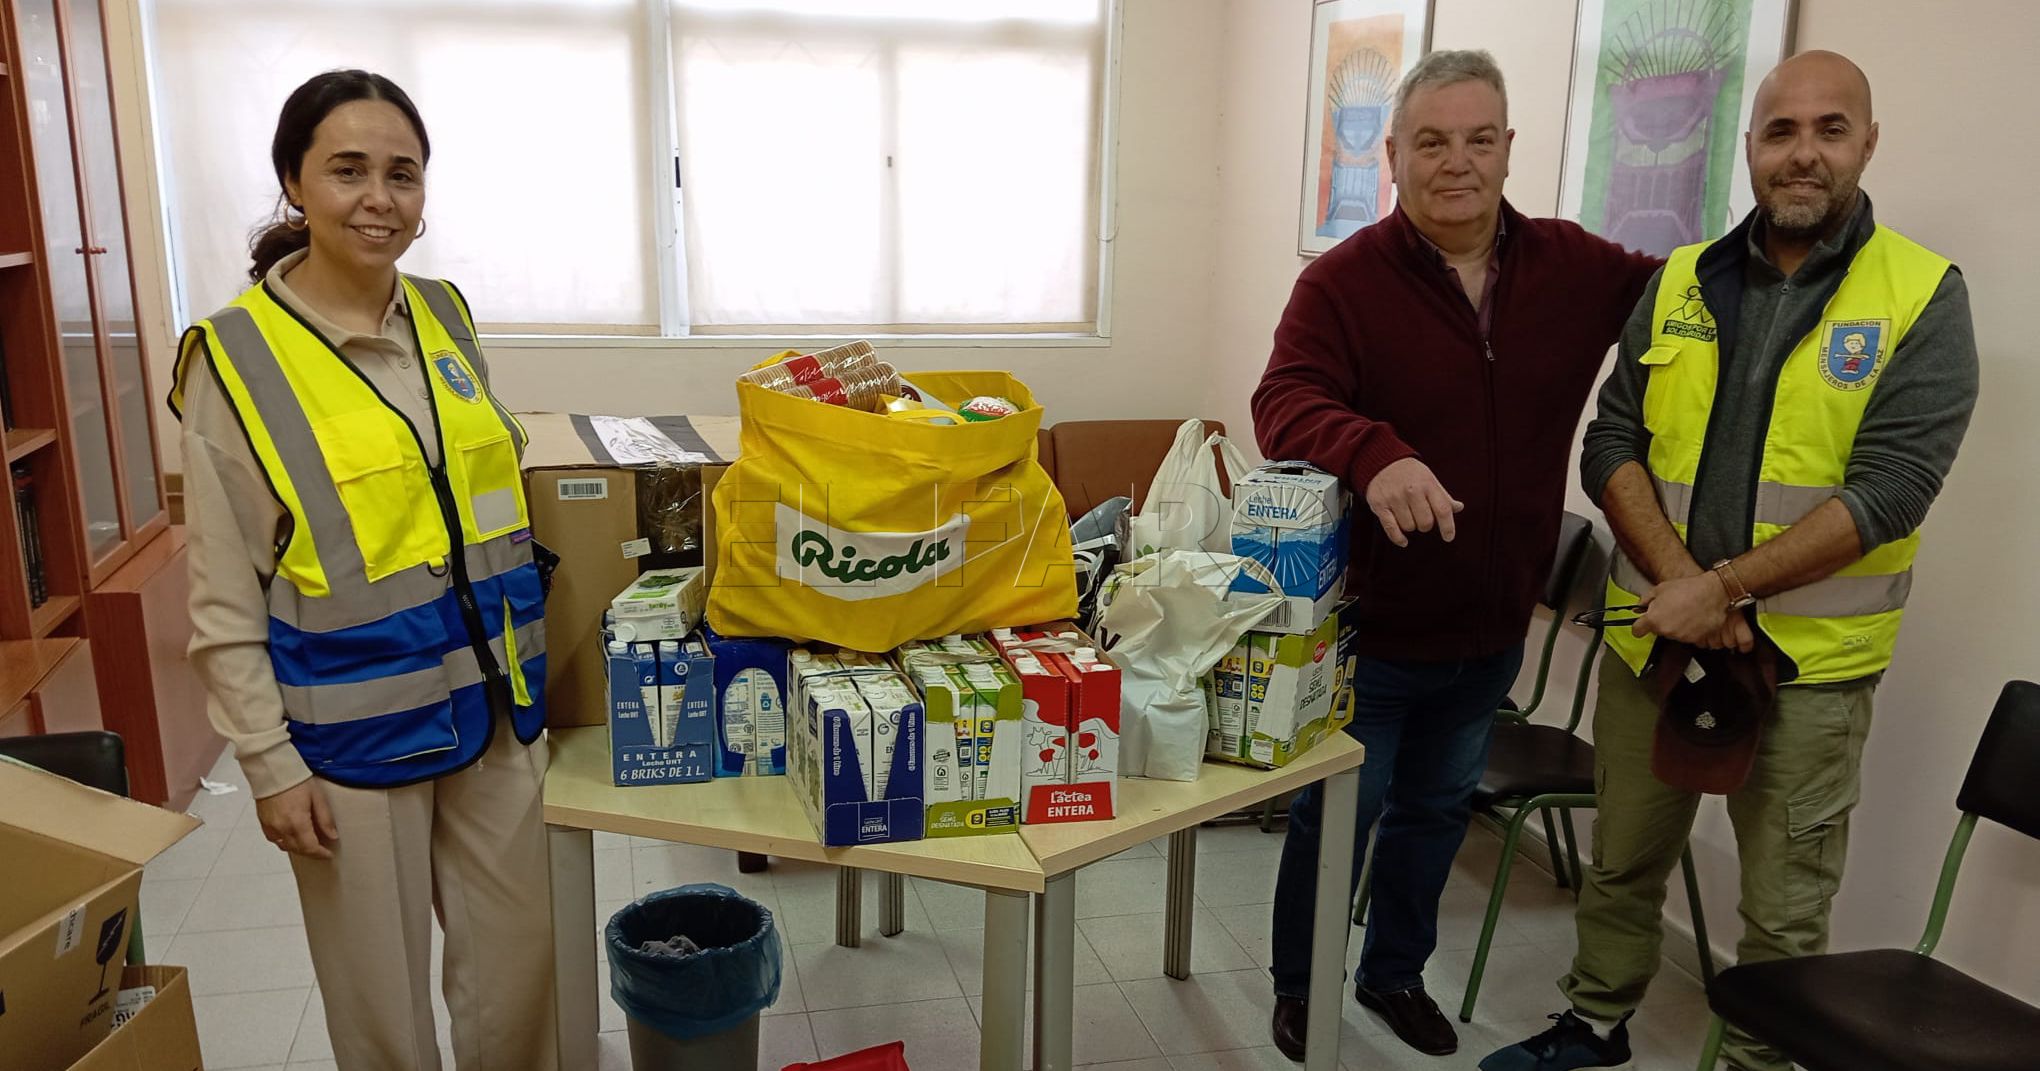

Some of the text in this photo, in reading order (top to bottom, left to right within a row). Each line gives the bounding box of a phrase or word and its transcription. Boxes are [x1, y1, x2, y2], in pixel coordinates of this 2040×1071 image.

[1820, 346, 1848, 389] MENSAJEROS
[1855, 380, 1866, 388] DE
[1870, 368, 1879, 378] LA
[1248, 504, 1298, 520] ENTERA
[791, 529, 951, 584] Ricola
[617, 701, 639, 709] ENTERA
[687, 700, 708, 709] ENTERA
[623, 750, 697, 761] ENTERA
[620, 769, 627, 780] 6
[631, 767, 666, 780] BRIKS
[668, 766, 683, 777] DE
[686, 766, 692, 776] 1
[1047, 804, 1094, 817] ENTERA
[861, 825, 887, 834] ENTERA
